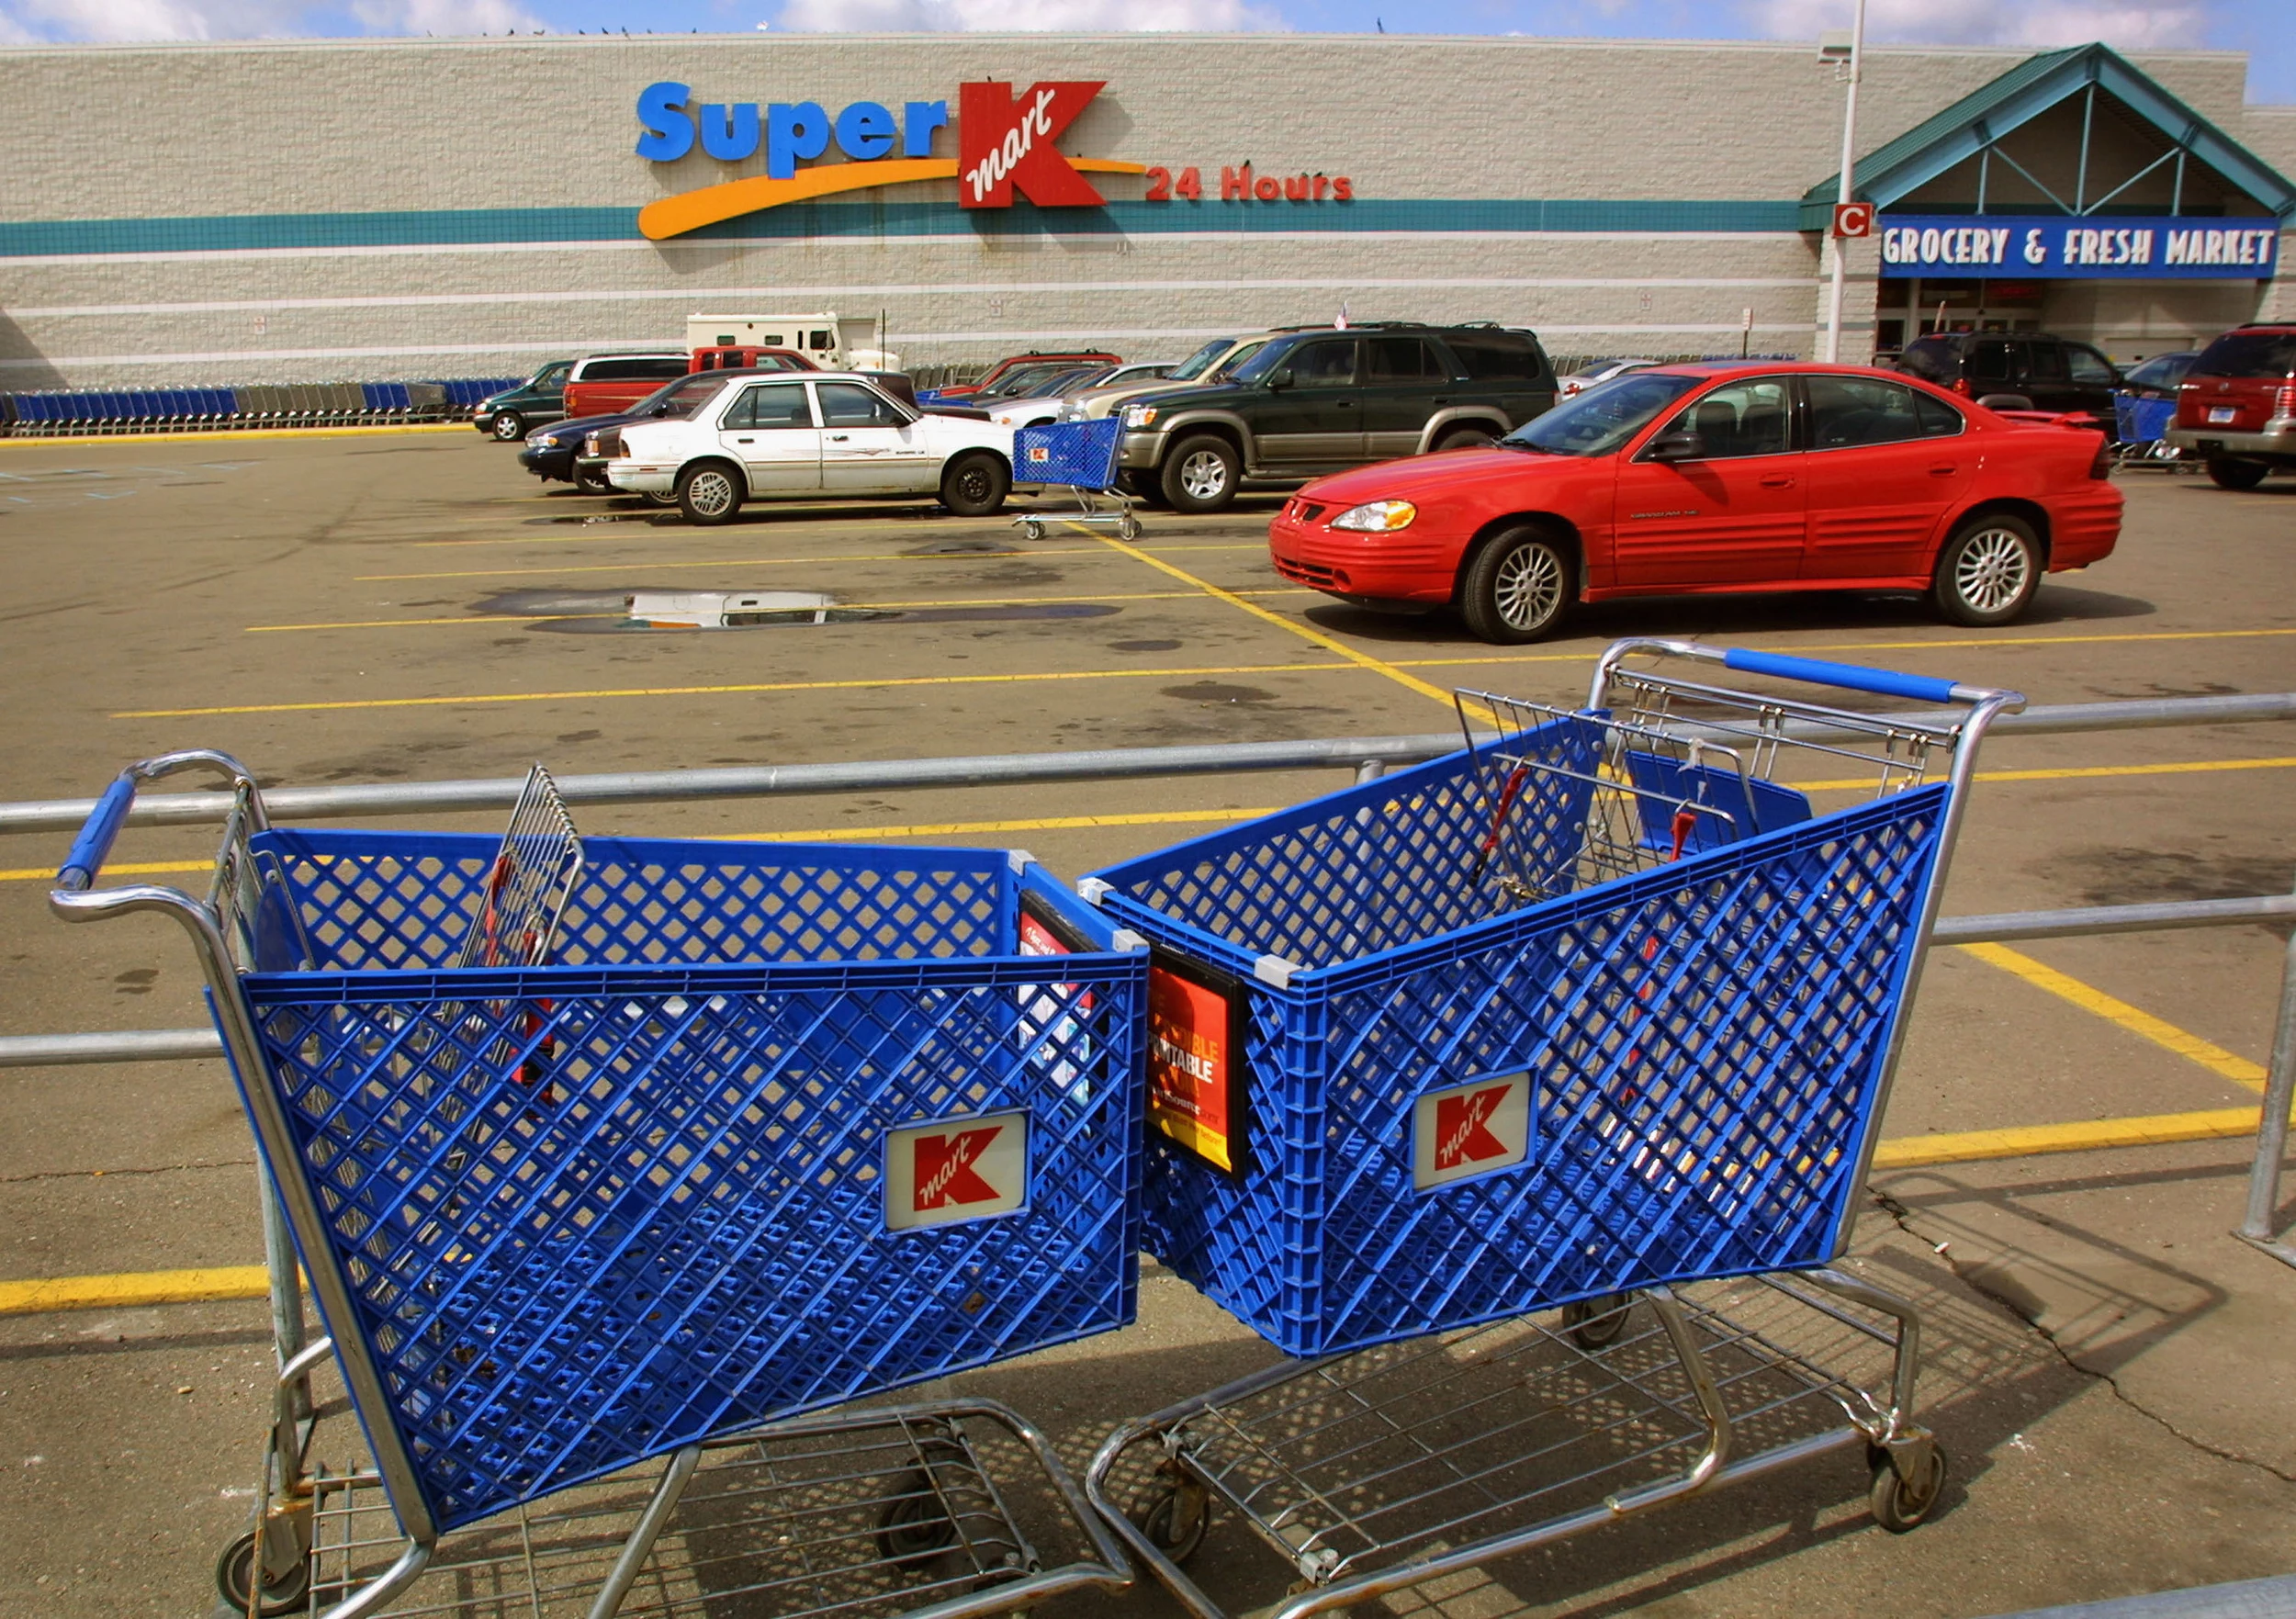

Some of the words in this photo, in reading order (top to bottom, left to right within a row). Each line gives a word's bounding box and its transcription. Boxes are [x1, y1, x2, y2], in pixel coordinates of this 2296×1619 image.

[636, 81, 948, 180] Super
[1144, 165, 1202, 202] 24
[1221, 165, 1353, 202] Hours
[1839, 207, 1867, 237] C
[1883, 227, 2010, 264] GROCERY
[2024, 228, 2047, 265] &
[2063, 229, 2154, 265] FRESH
[2165, 229, 2275, 266] MARKET
